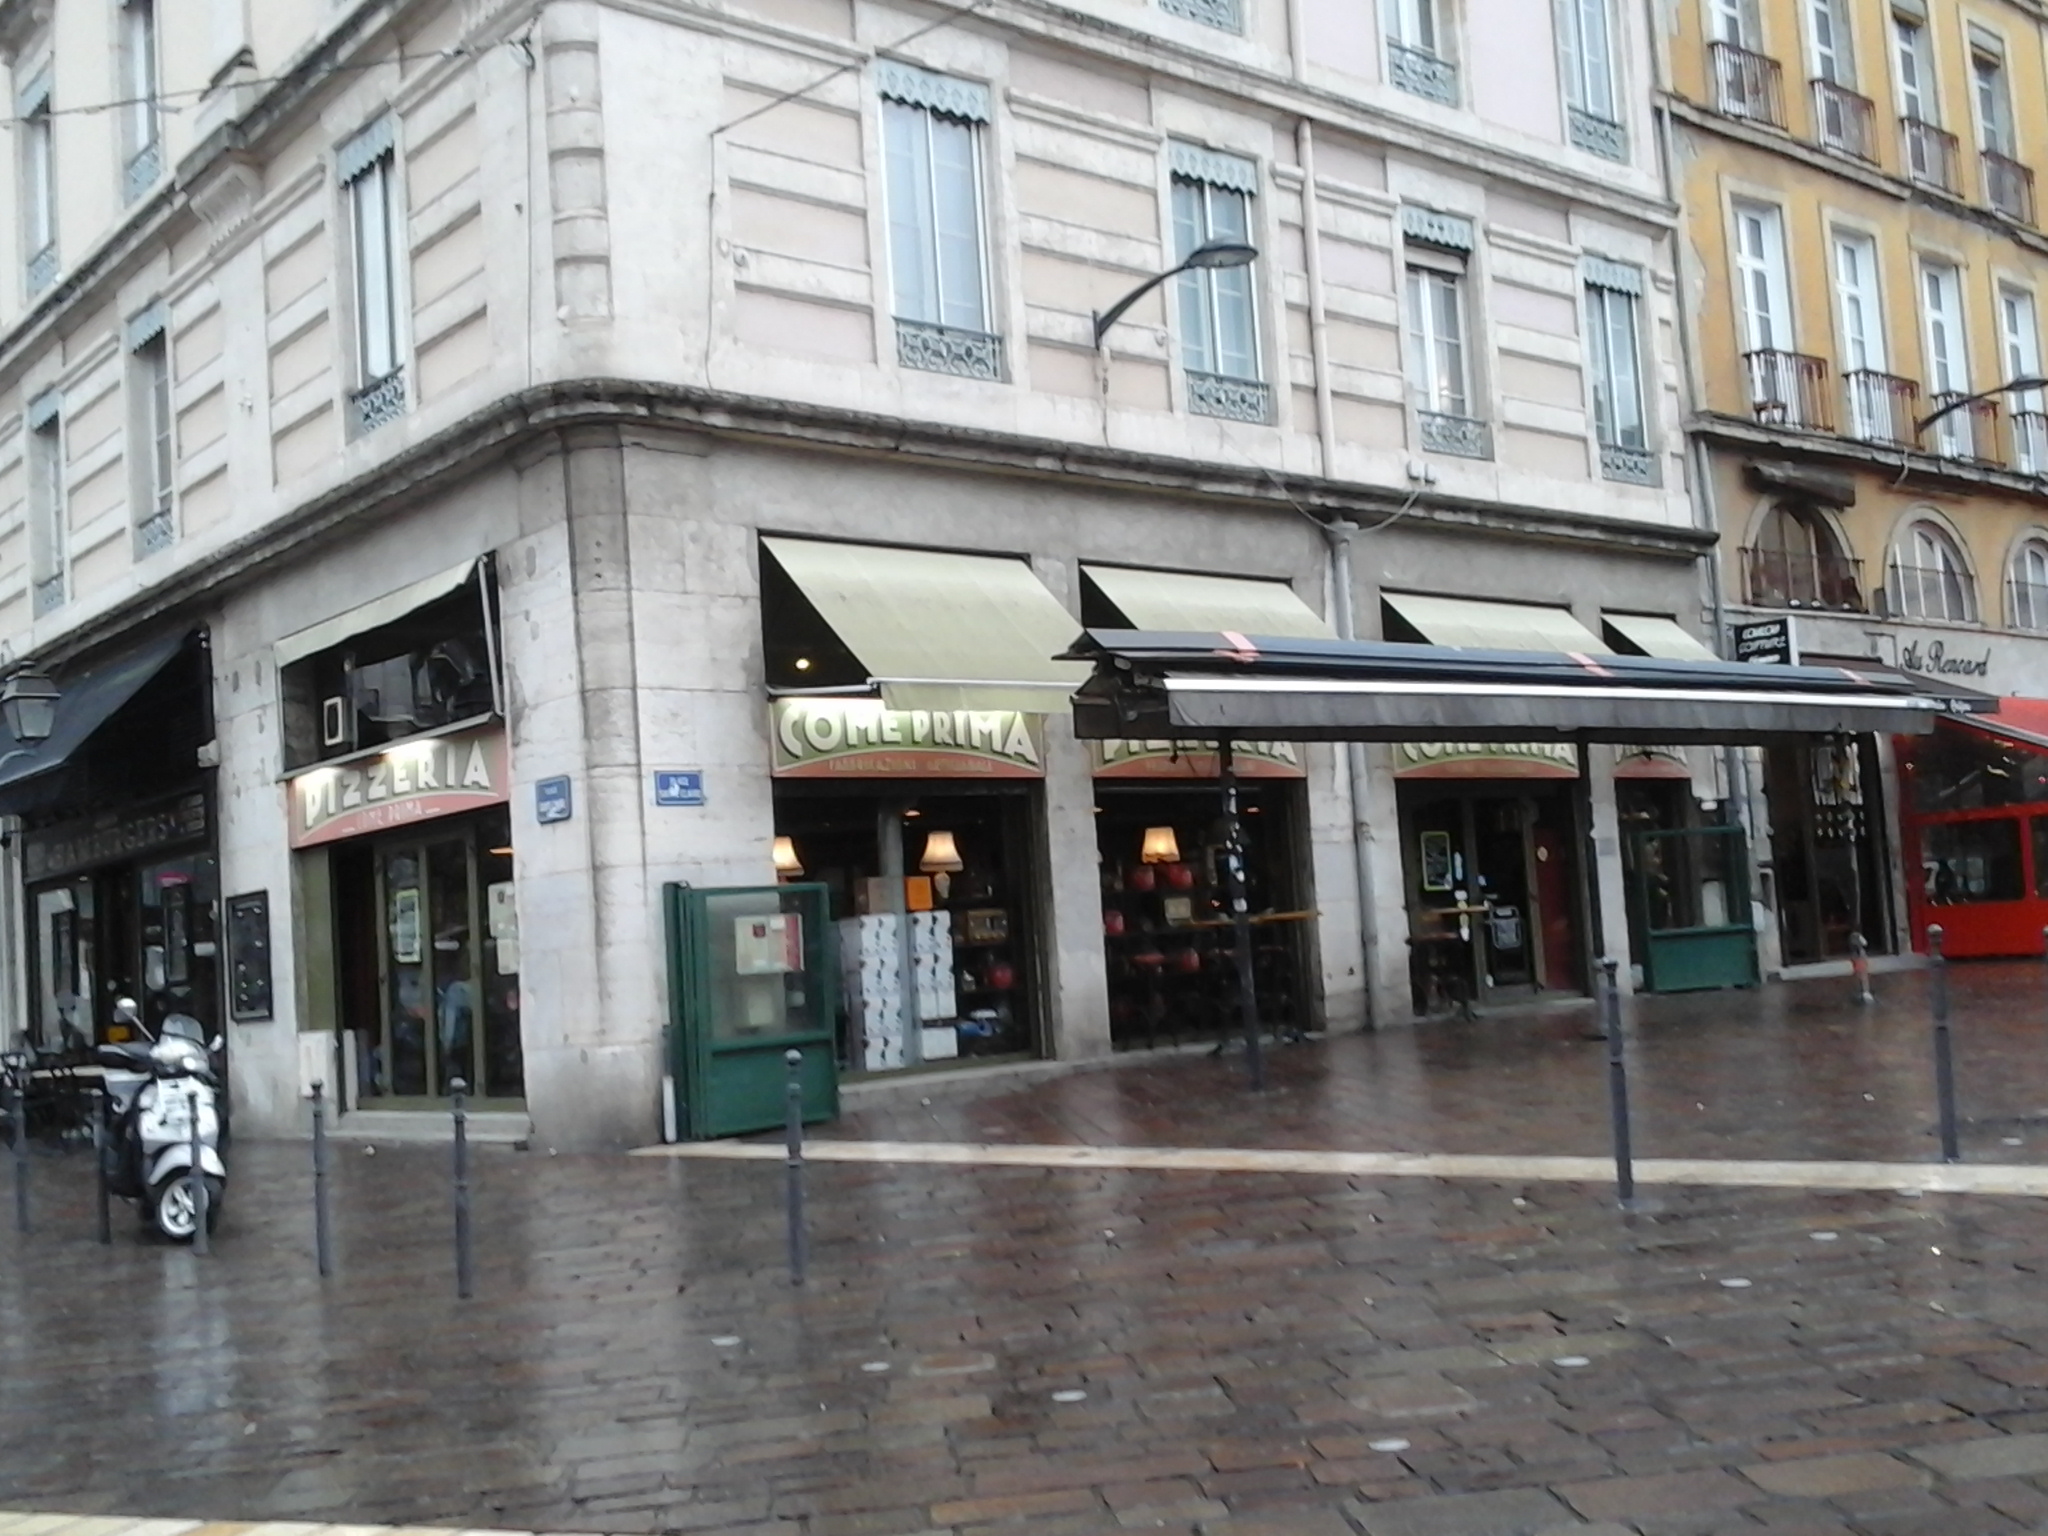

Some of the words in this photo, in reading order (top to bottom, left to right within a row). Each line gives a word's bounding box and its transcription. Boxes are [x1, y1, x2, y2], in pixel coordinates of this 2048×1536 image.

[779, 701, 902, 758] COME
[911, 710, 1039, 765] PRIMA
[303, 740, 491, 830] PIZZERIA
